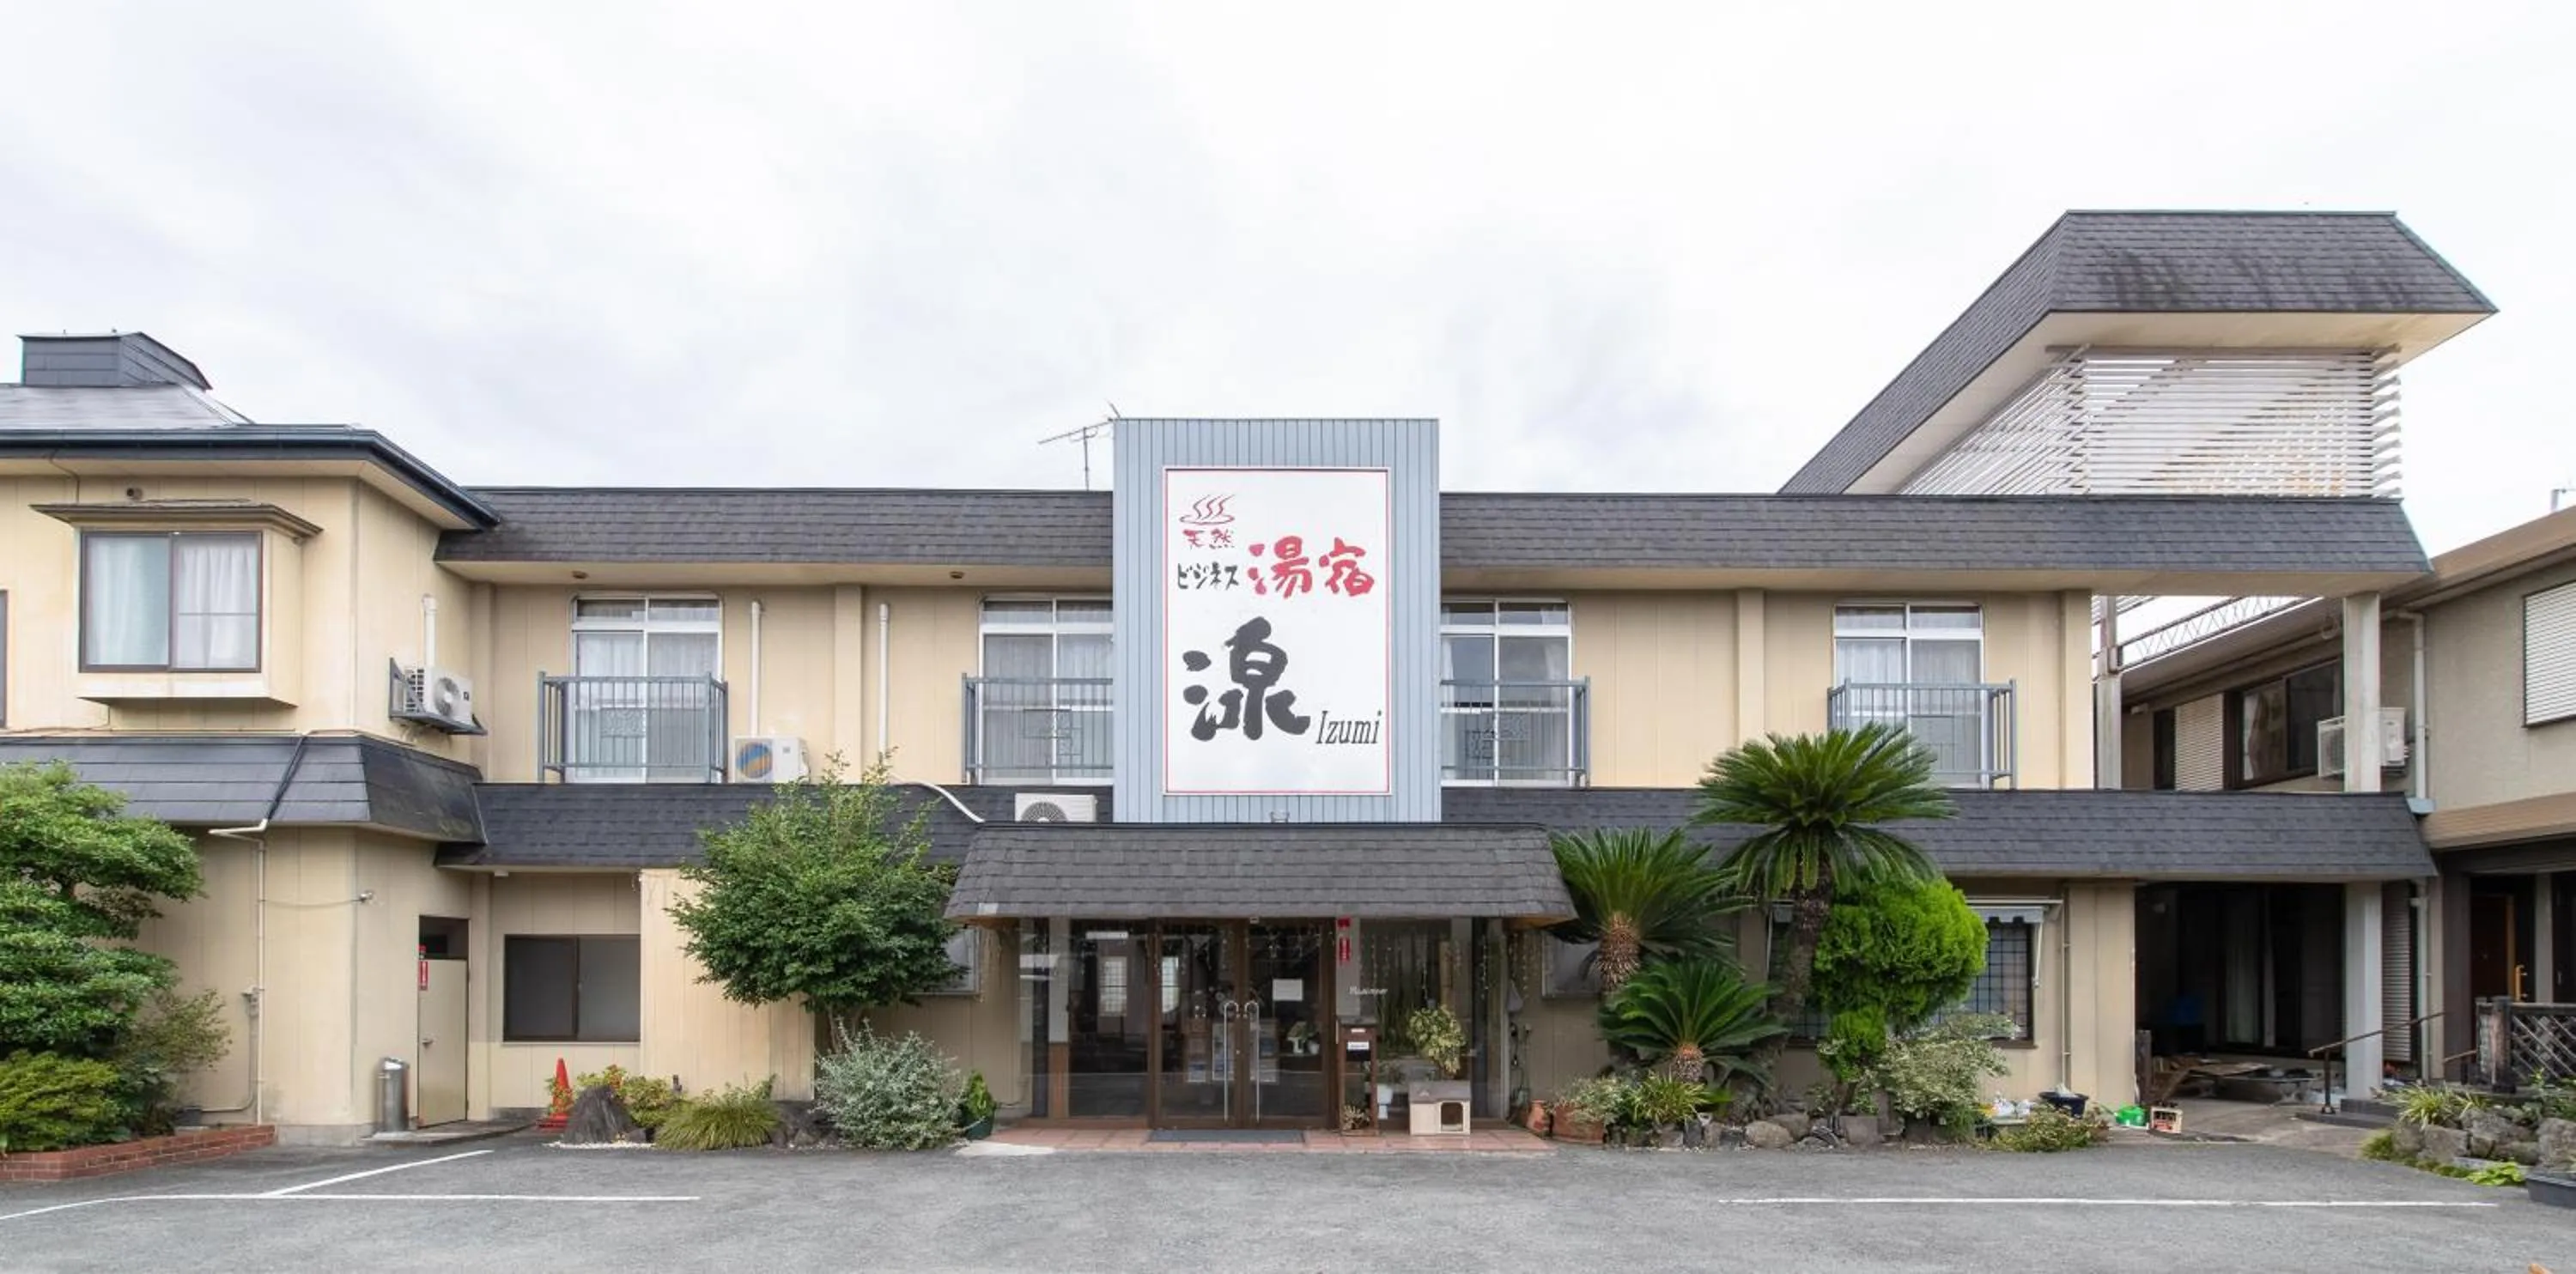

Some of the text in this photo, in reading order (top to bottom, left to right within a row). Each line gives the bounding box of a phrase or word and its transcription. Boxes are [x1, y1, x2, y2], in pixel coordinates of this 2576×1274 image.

[1182, 528, 1236, 550] 天然
[1177, 535, 1376, 599] ビジネス 湯宿
[1315, 710, 1382, 746] Izumi
